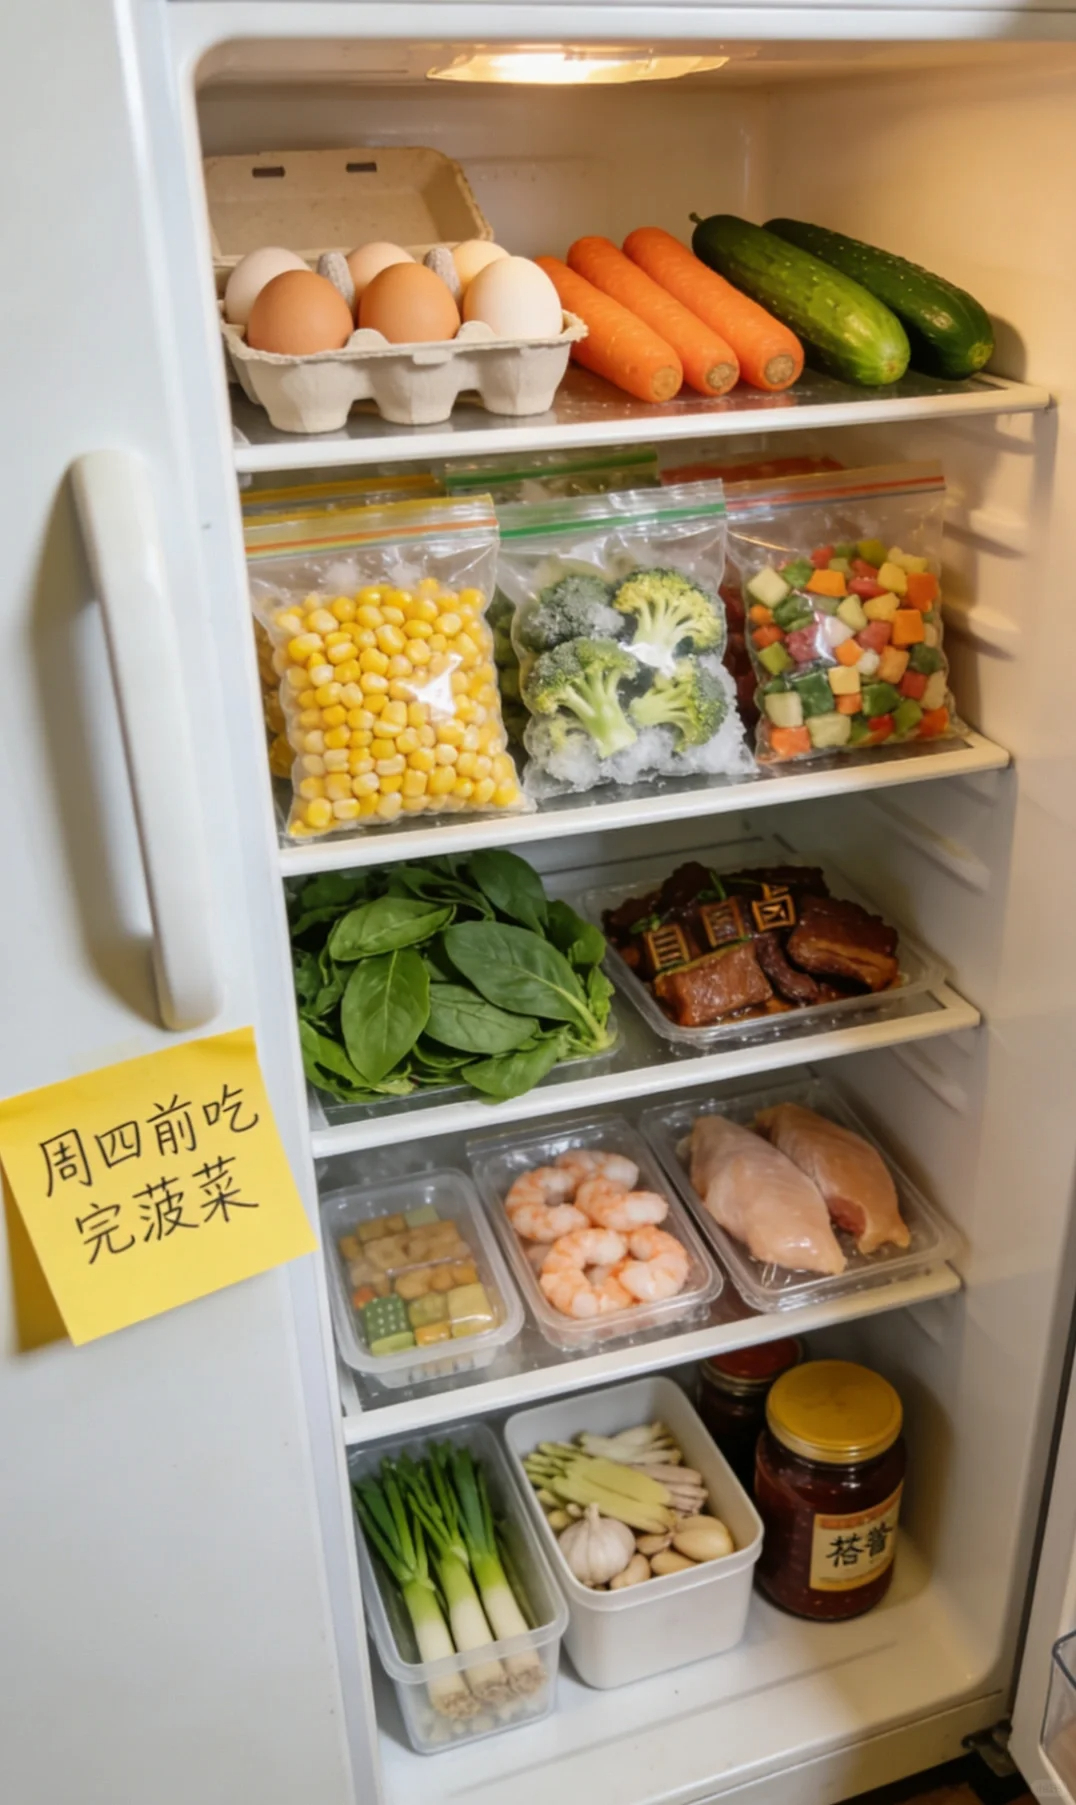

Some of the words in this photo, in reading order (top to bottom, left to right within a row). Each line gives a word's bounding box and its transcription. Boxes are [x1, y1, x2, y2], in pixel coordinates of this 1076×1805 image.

[39, 1083, 259, 1198] 周四前吃
[75, 1155, 259, 1265] 完菠菜
